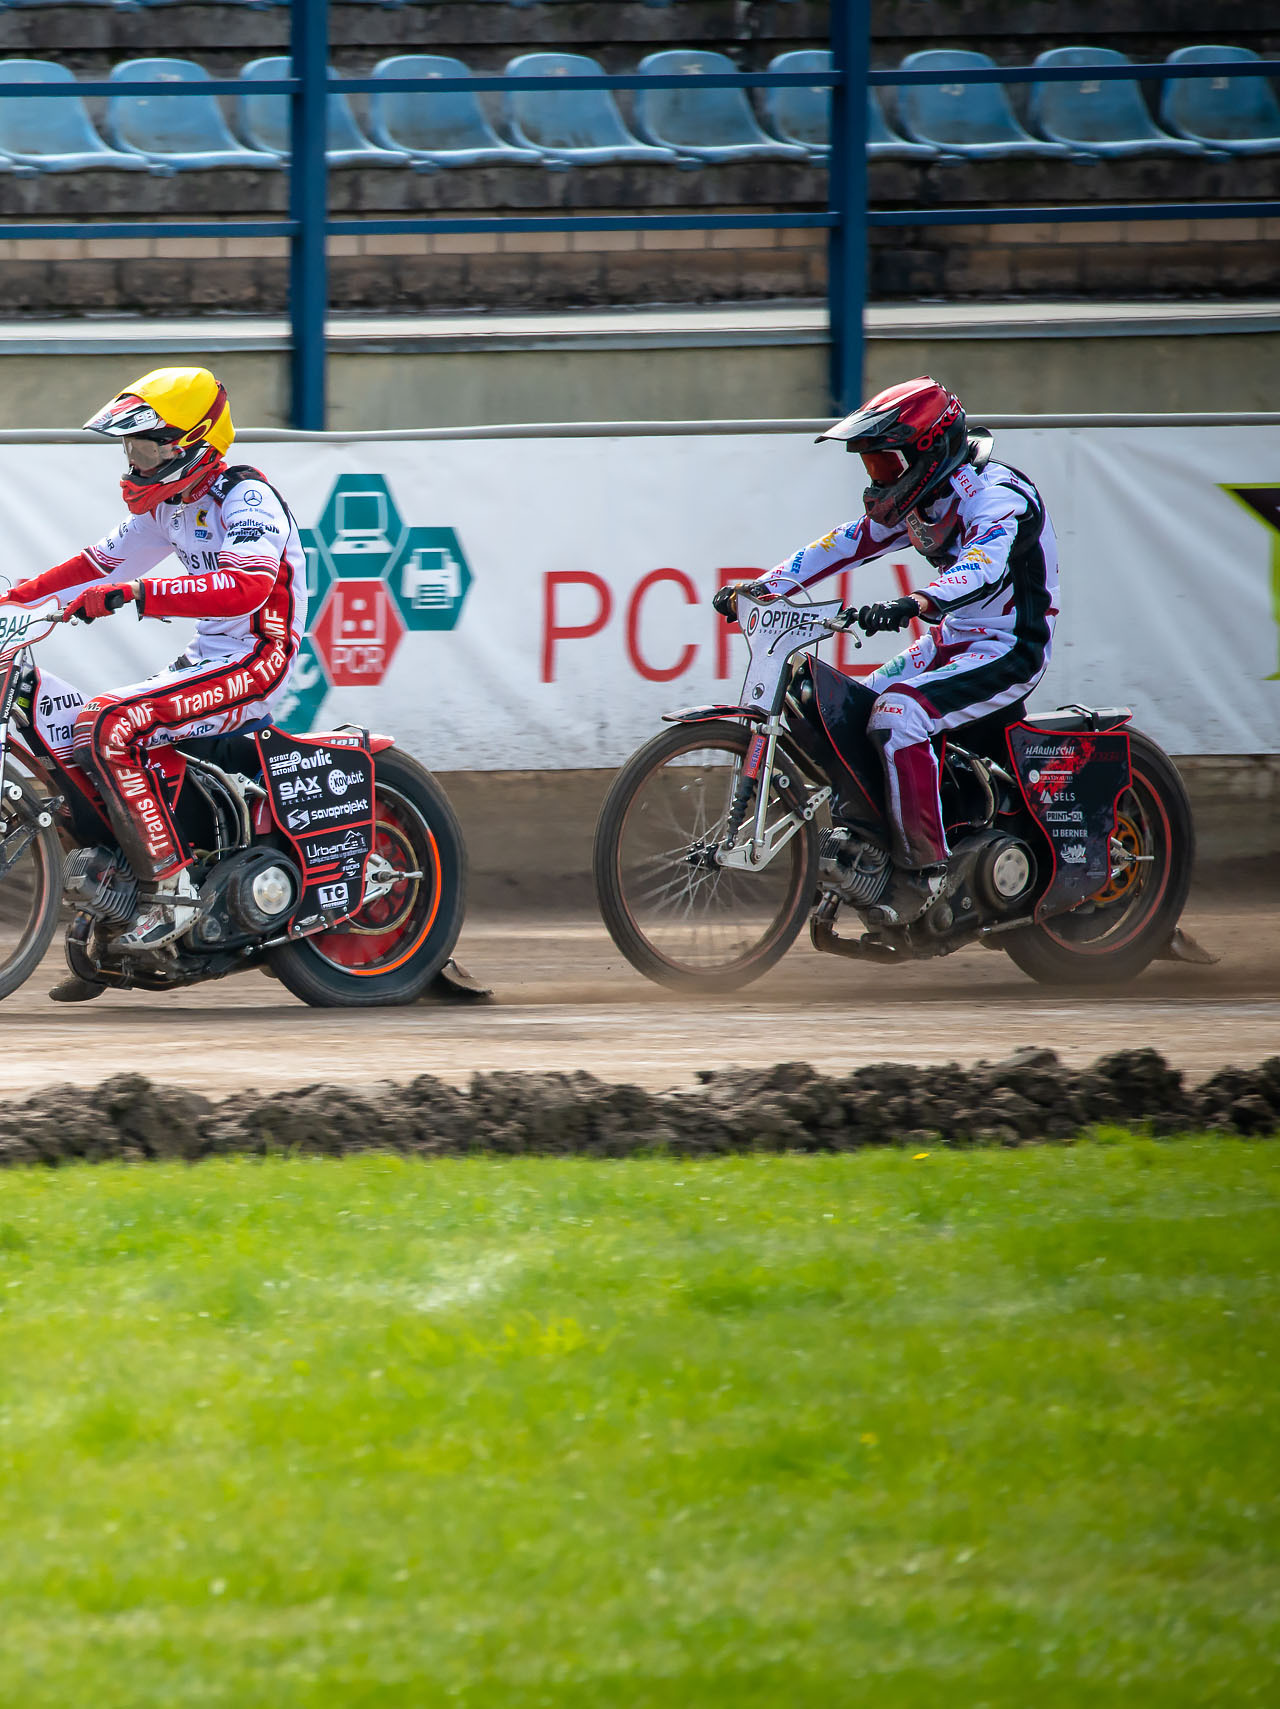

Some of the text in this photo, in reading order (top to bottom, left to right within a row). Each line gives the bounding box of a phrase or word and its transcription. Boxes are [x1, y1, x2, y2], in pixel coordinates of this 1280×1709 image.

[958, 474, 977, 498] SELS
[149, 577, 208, 596] Trans
[264, 608, 285, 639] MF
[762, 610, 819, 631] OPTIBET
[331, 647, 386, 673] PCR
[909, 645, 925, 669] ELS
[171, 672, 255, 717] Trans MF
[127, 701, 154, 729] MF
[47, 724, 74, 742] Tra
[751, 738, 765, 768] BERNER
[117, 768, 148, 798] MF
[1053, 792, 1076, 801] SELS
[137, 798, 170, 856] Trans
[1060, 829, 1088, 837] BERNER
[323, 885, 345, 901] TC
